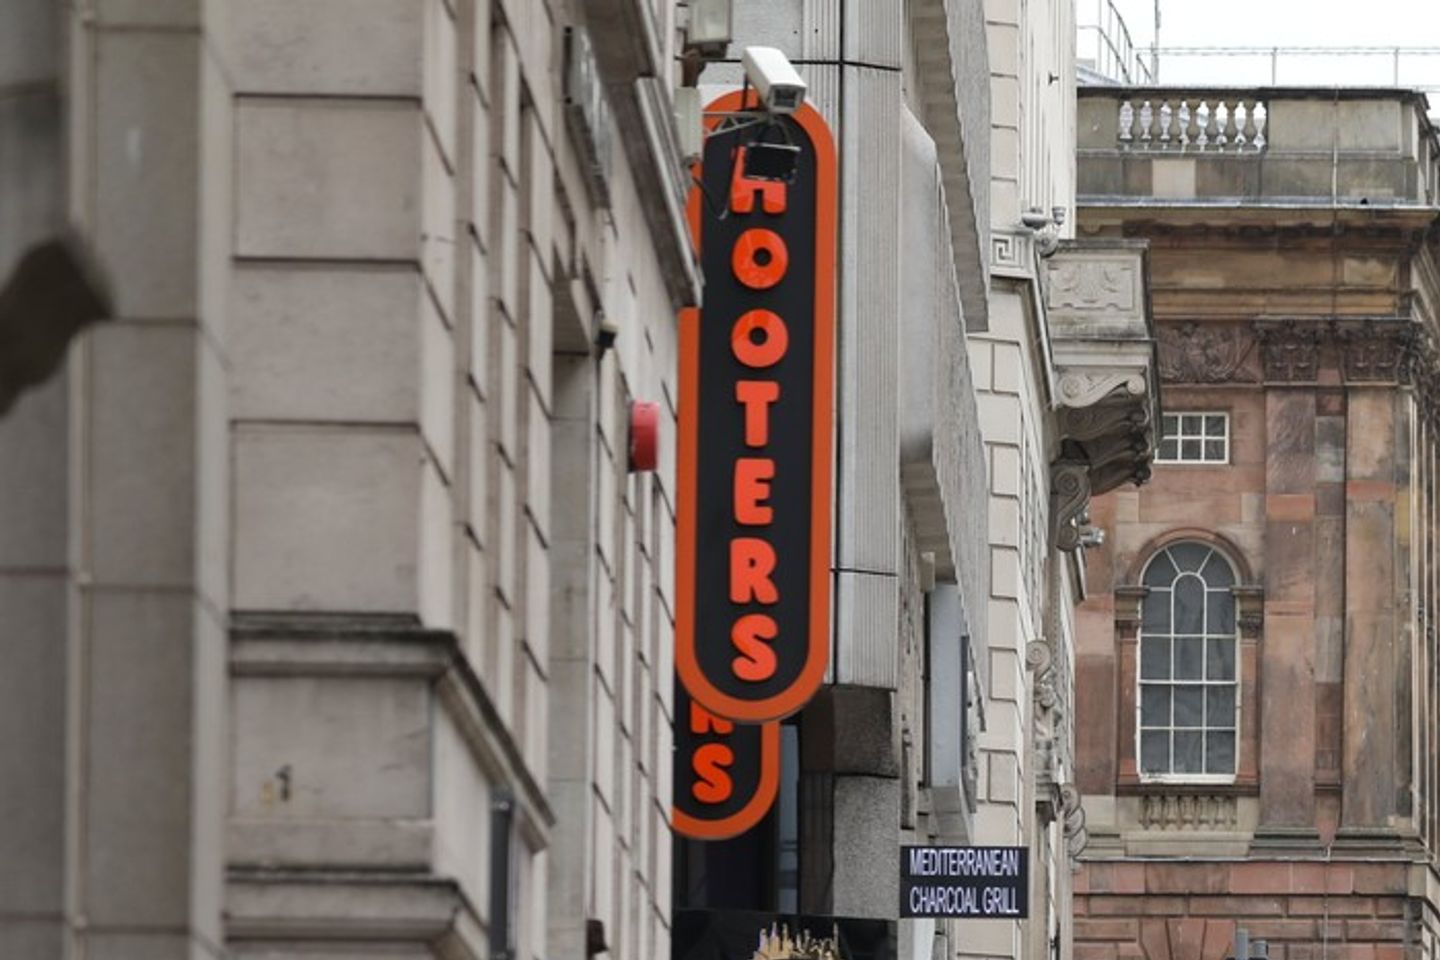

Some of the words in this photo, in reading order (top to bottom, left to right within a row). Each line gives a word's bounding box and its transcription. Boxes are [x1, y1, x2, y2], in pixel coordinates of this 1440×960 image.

[909, 848, 1019, 876] MEDITERRANEAN
[909, 886, 980, 914] CHARCOAL
[982, 886, 1019, 914] GRILL
